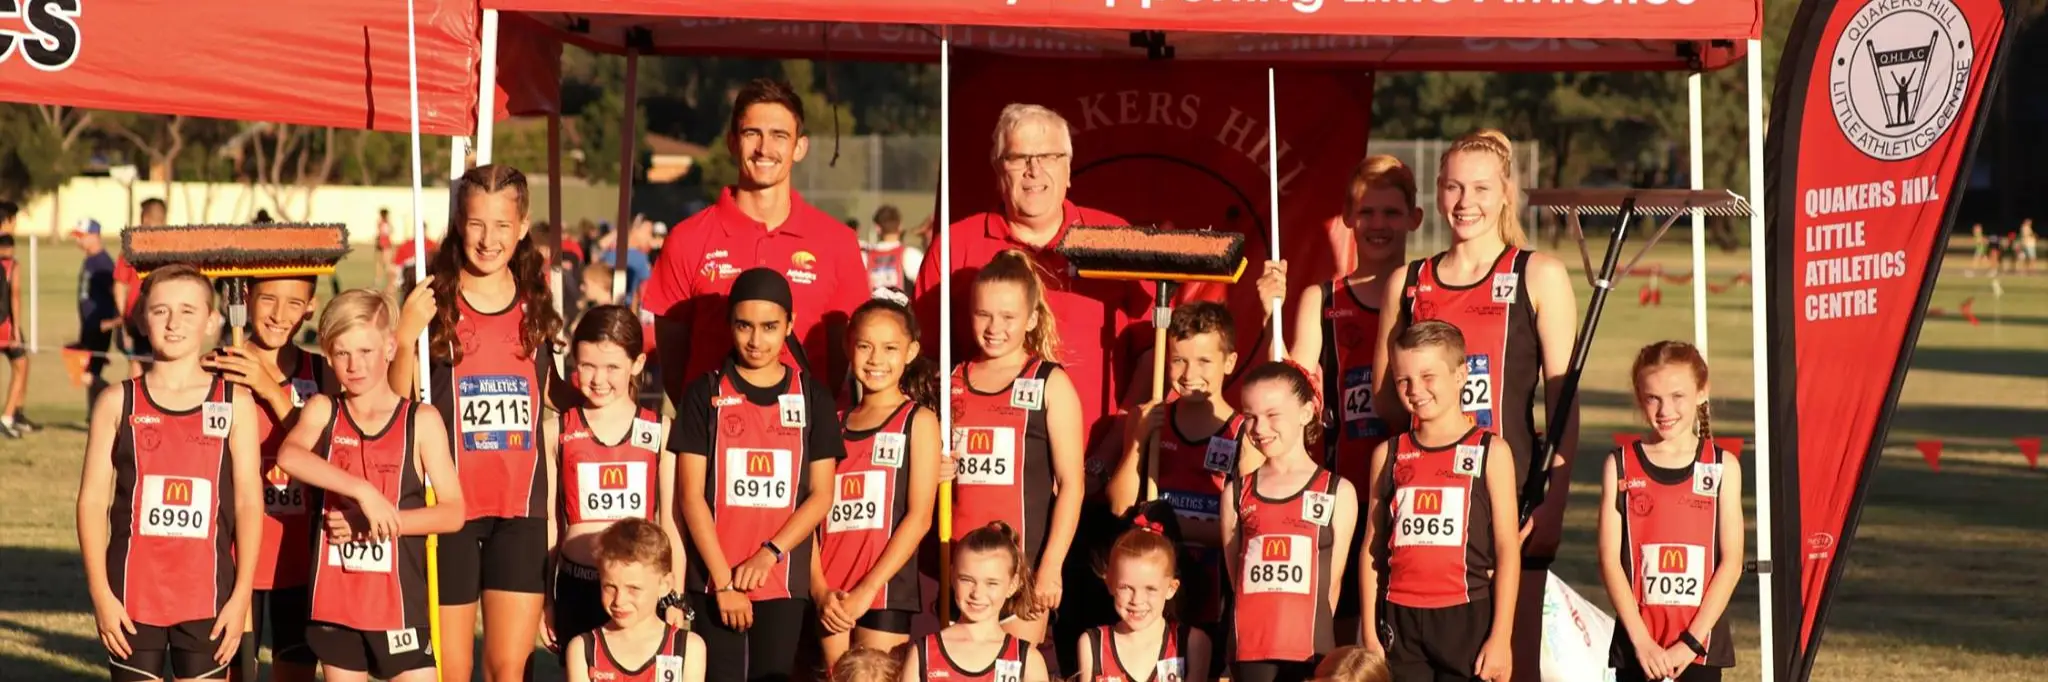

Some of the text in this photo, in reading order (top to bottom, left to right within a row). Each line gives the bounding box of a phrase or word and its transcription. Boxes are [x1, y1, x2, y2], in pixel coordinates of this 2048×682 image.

[1848, 0, 1957, 41] QUAKERS HILL
[1068, 90, 1201, 135] KERS
[1833, 58, 1971, 157] LITTLE ATHLETICS CENTRE
[1805, 174, 1939, 218] QUAKERS HILL
[1806, 220, 1866, 252] LITTLE
[1805, 250, 1906, 287] ATHLETICS
[1494, 285, 1515, 298] 17
[1805, 288, 1877, 321] CENTRE
[479, 379, 519, 393] ATHLETICS
[1018, 390, 1034, 403] 11
[462, 399, 529, 426] 42115
[786, 410, 801, 423] 11
[209, 416, 226, 430] 10
[641, 432, 653, 444] 9
[878, 448, 895, 460] 11
[1211, 452, 1229, 467] 12
[958, 457, 1006, 475] 6845
[1462, 457, 1474, 471] 8
[734, 479, 786, 499] 6916
[1703, 476, 1714, 491] 9
[588, 492, 641, 510] 6919
[149, 508, 203, 529] 6990
[832, 501, 876, 522] 6929
[1312, 503, 1324, 519] 9
[1402, 517, 1454, 536] 6965
[343, 541, 384, 562] 070
[1250, 564, 1303, 583] 6850
[1646, 576, 1697, 596] 7032
[393, 633, 412, 648] 10
[664, 669, 674, 682] 9
